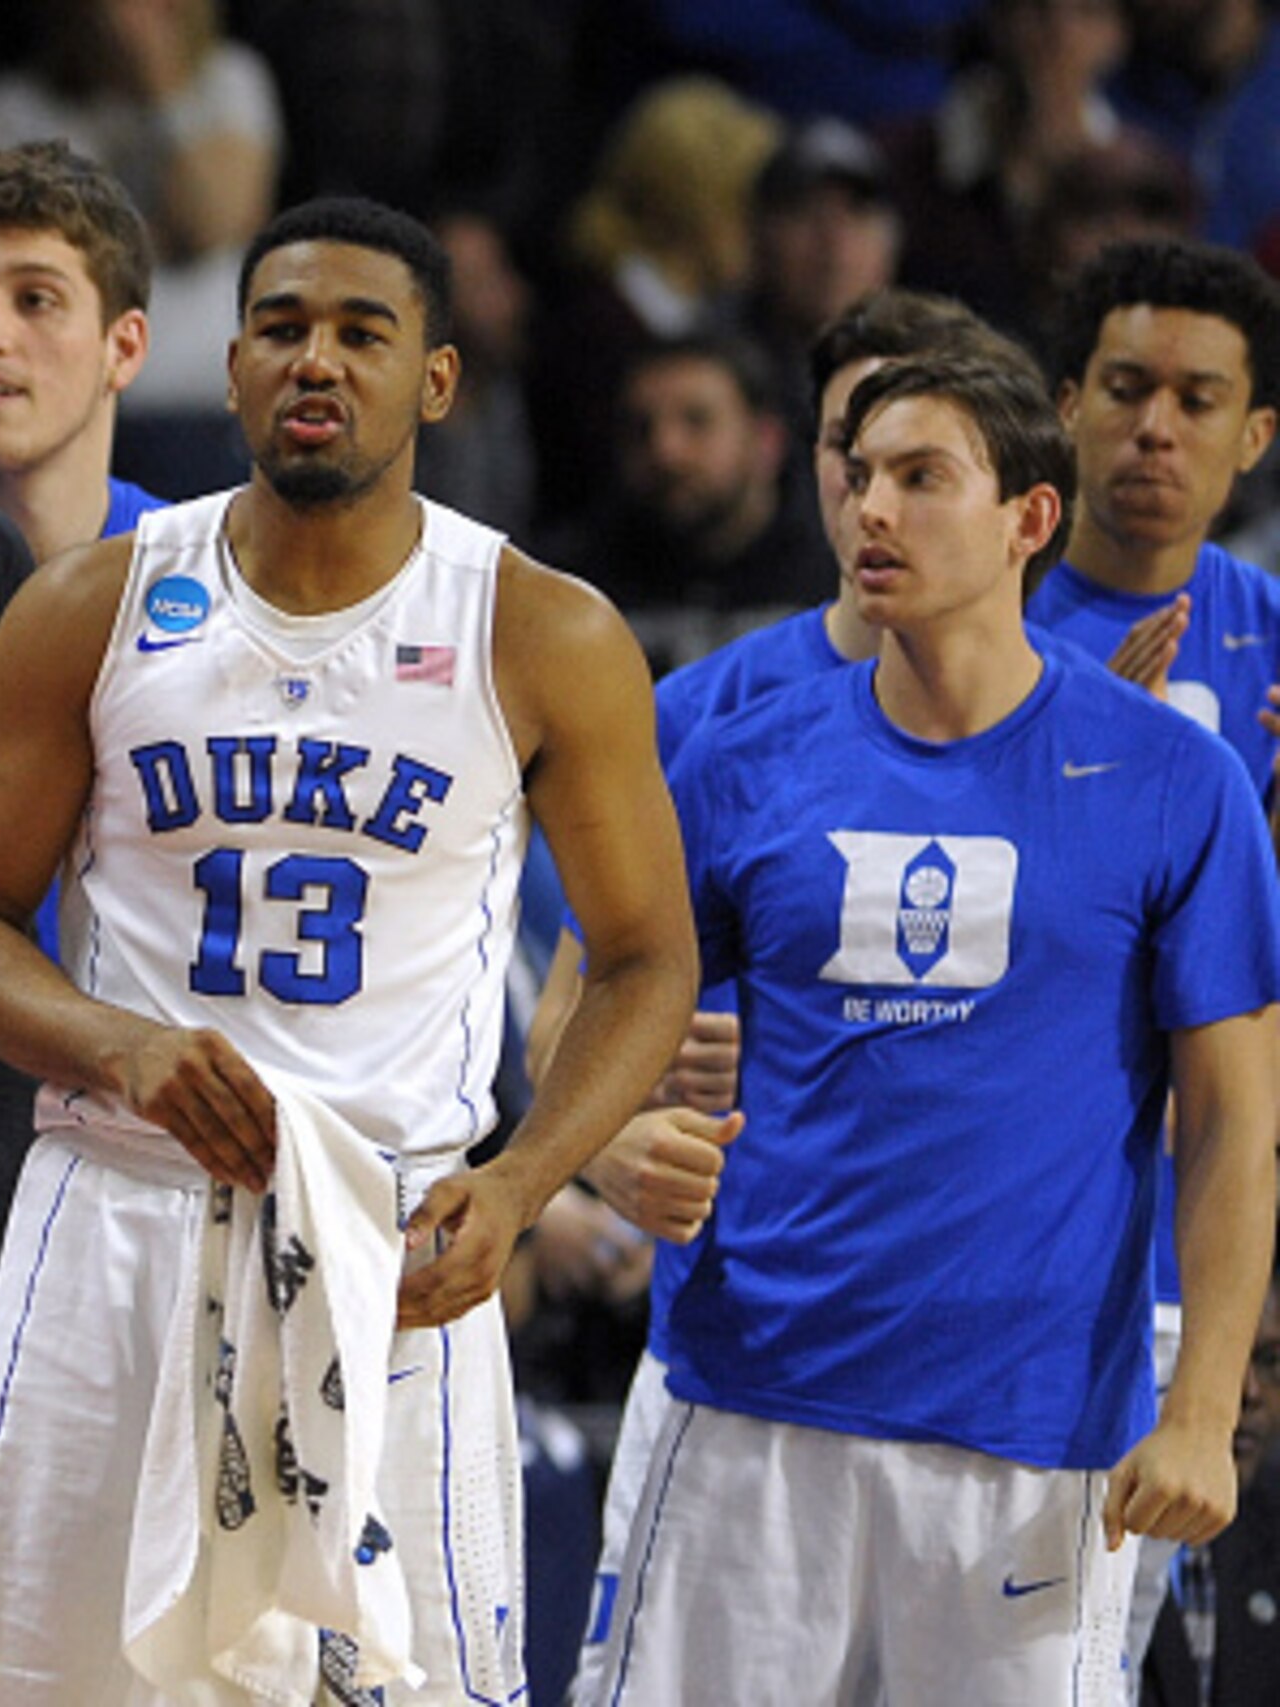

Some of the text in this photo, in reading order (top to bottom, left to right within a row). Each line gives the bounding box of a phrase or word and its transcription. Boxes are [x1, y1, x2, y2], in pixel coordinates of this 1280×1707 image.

[152, 598, 203, 618] NCAA
[128, 734, 454, 854] DUKE
[188, 846, 370, 1006] 13
[843, 996, 871, 1023] BE
